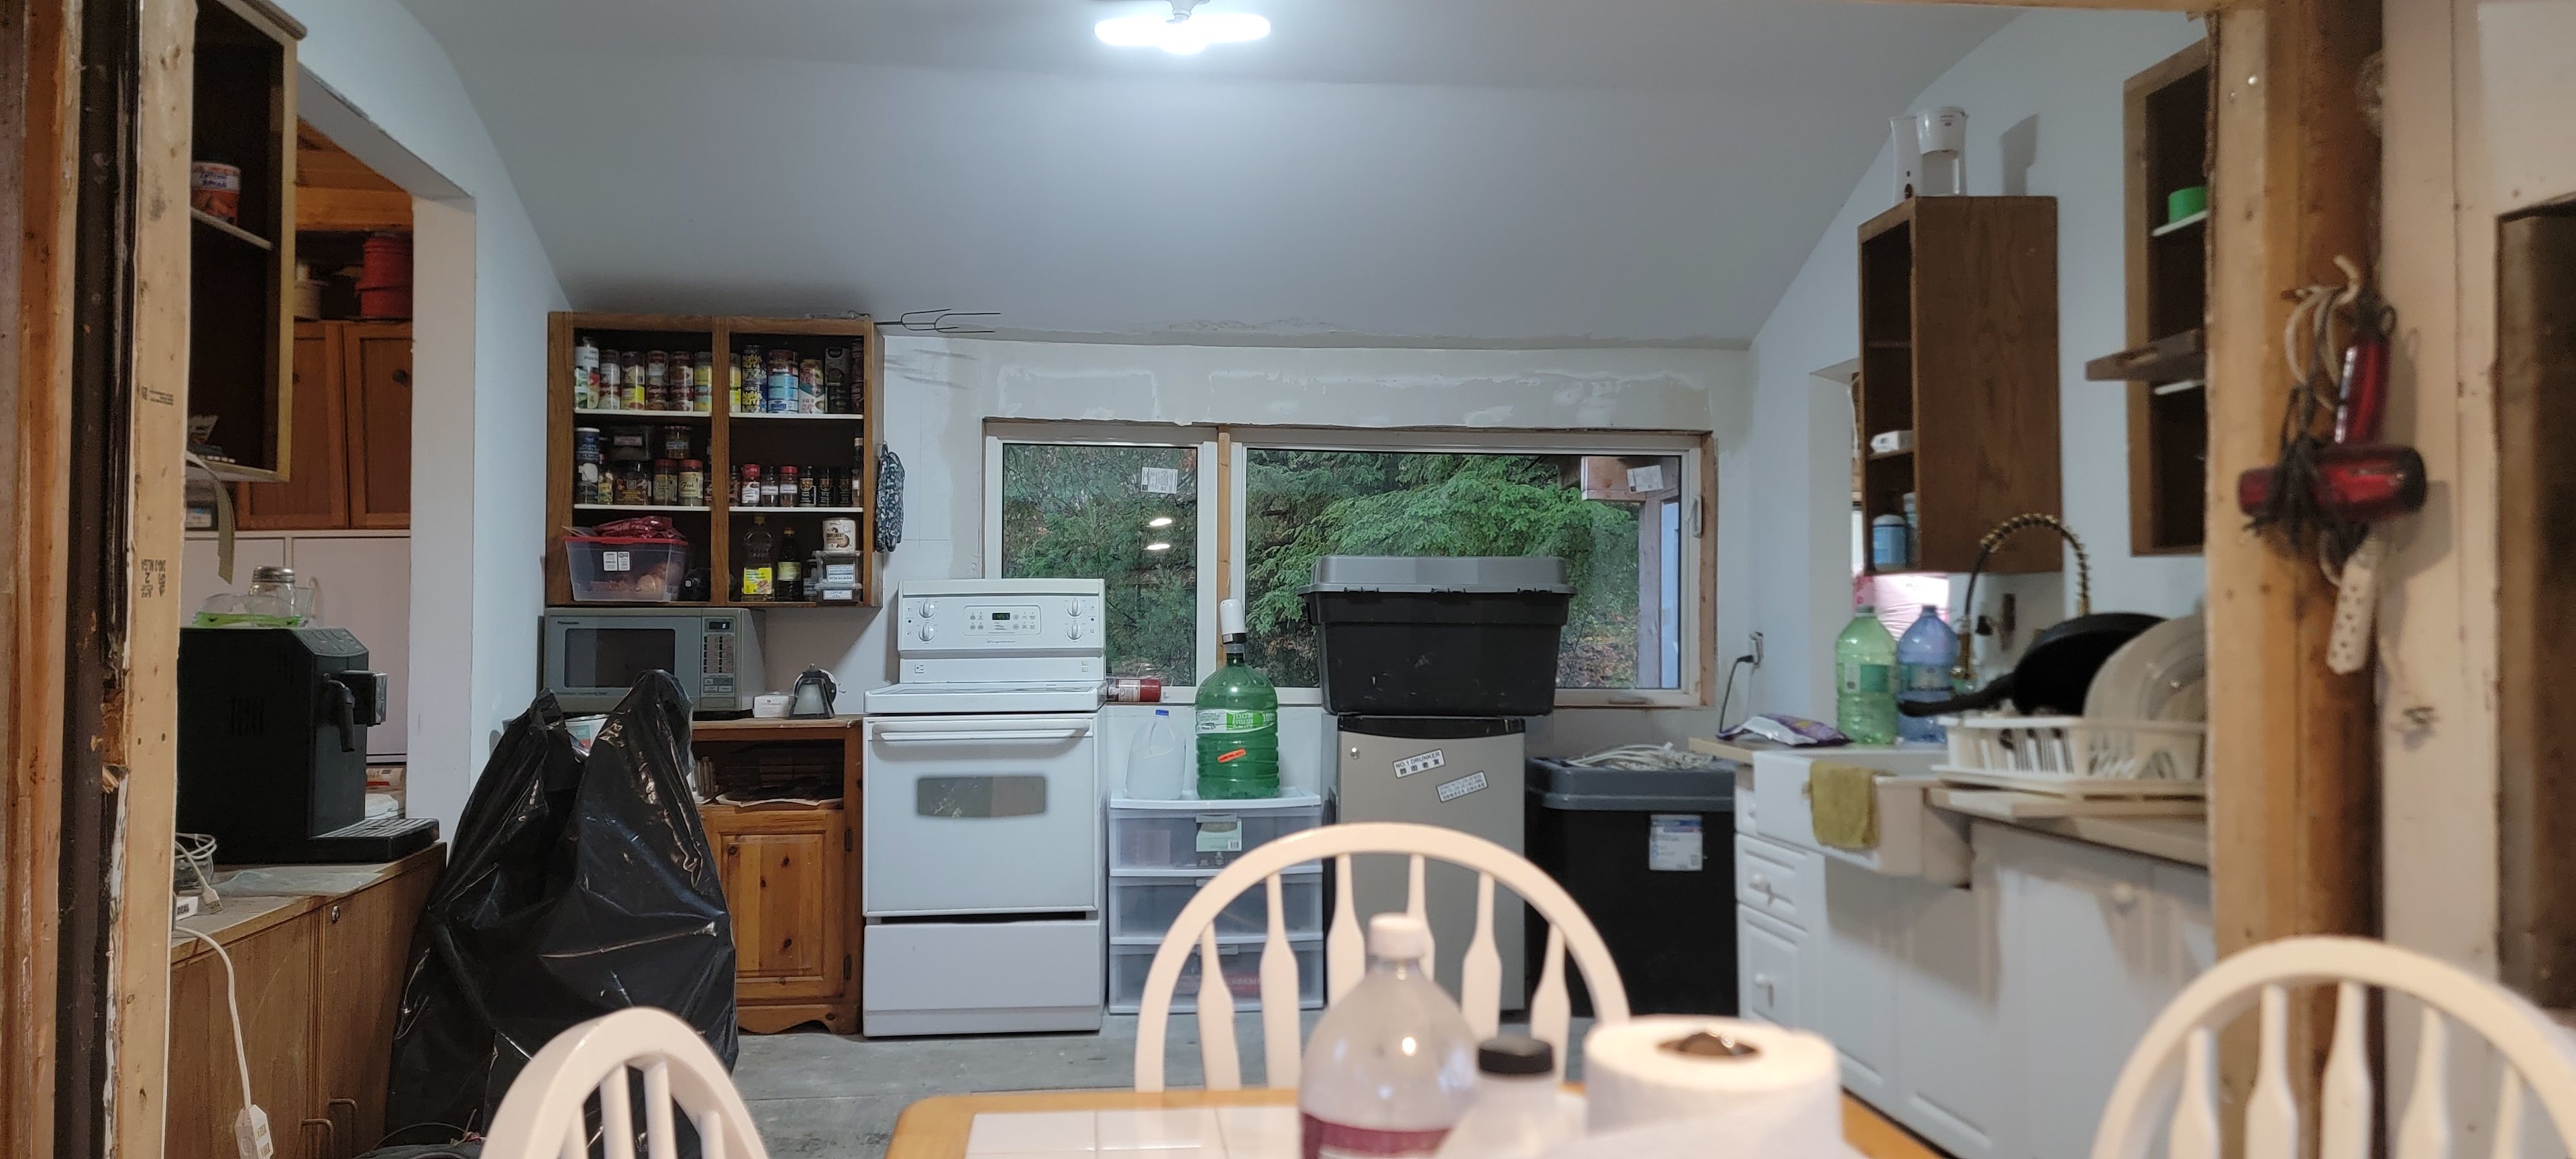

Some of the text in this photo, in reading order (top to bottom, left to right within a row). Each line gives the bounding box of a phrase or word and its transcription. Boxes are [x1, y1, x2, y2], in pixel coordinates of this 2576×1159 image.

[145, 572, 150, 584] 2
[1395, 761, 1409, 769] NO.1
[1411, 752, 1440, 765] DRUNKER
